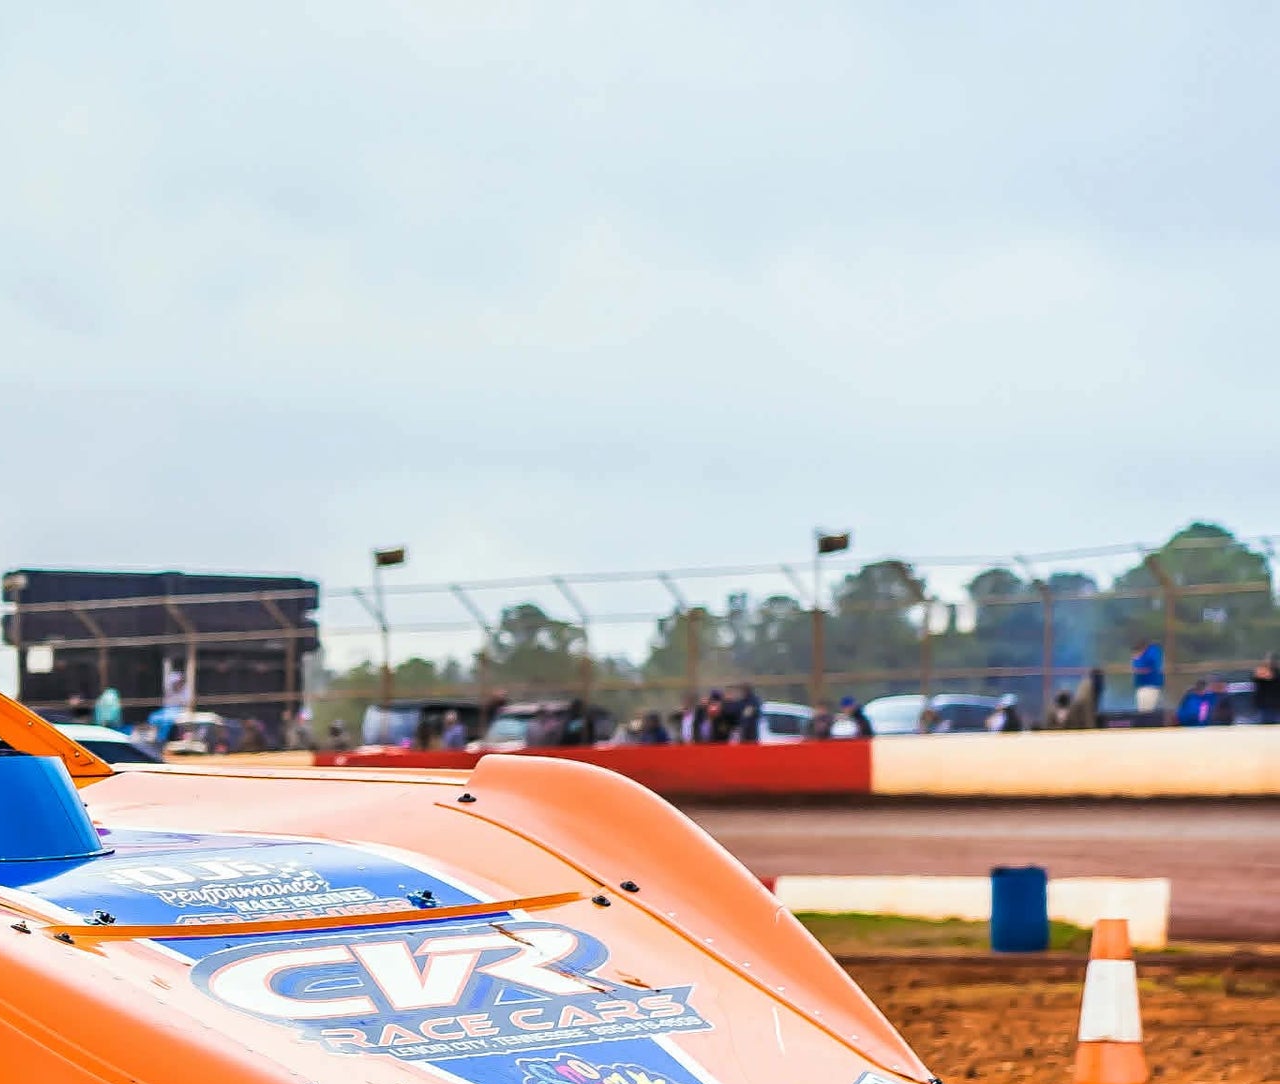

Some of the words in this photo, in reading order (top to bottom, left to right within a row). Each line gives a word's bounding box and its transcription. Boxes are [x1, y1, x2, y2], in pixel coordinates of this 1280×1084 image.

[159, 875, 326, 905] Performance
[233, 897, 286, 912] RACE
[209, 926, 614, 1020] CVR
[324, 1012, 501, 1048] RACE
[509, 994, 686, 1031] CARS
[389, 1043, 451, 1056] LENOIR
[491, 1028, 590, 1047] TENNESSEE
